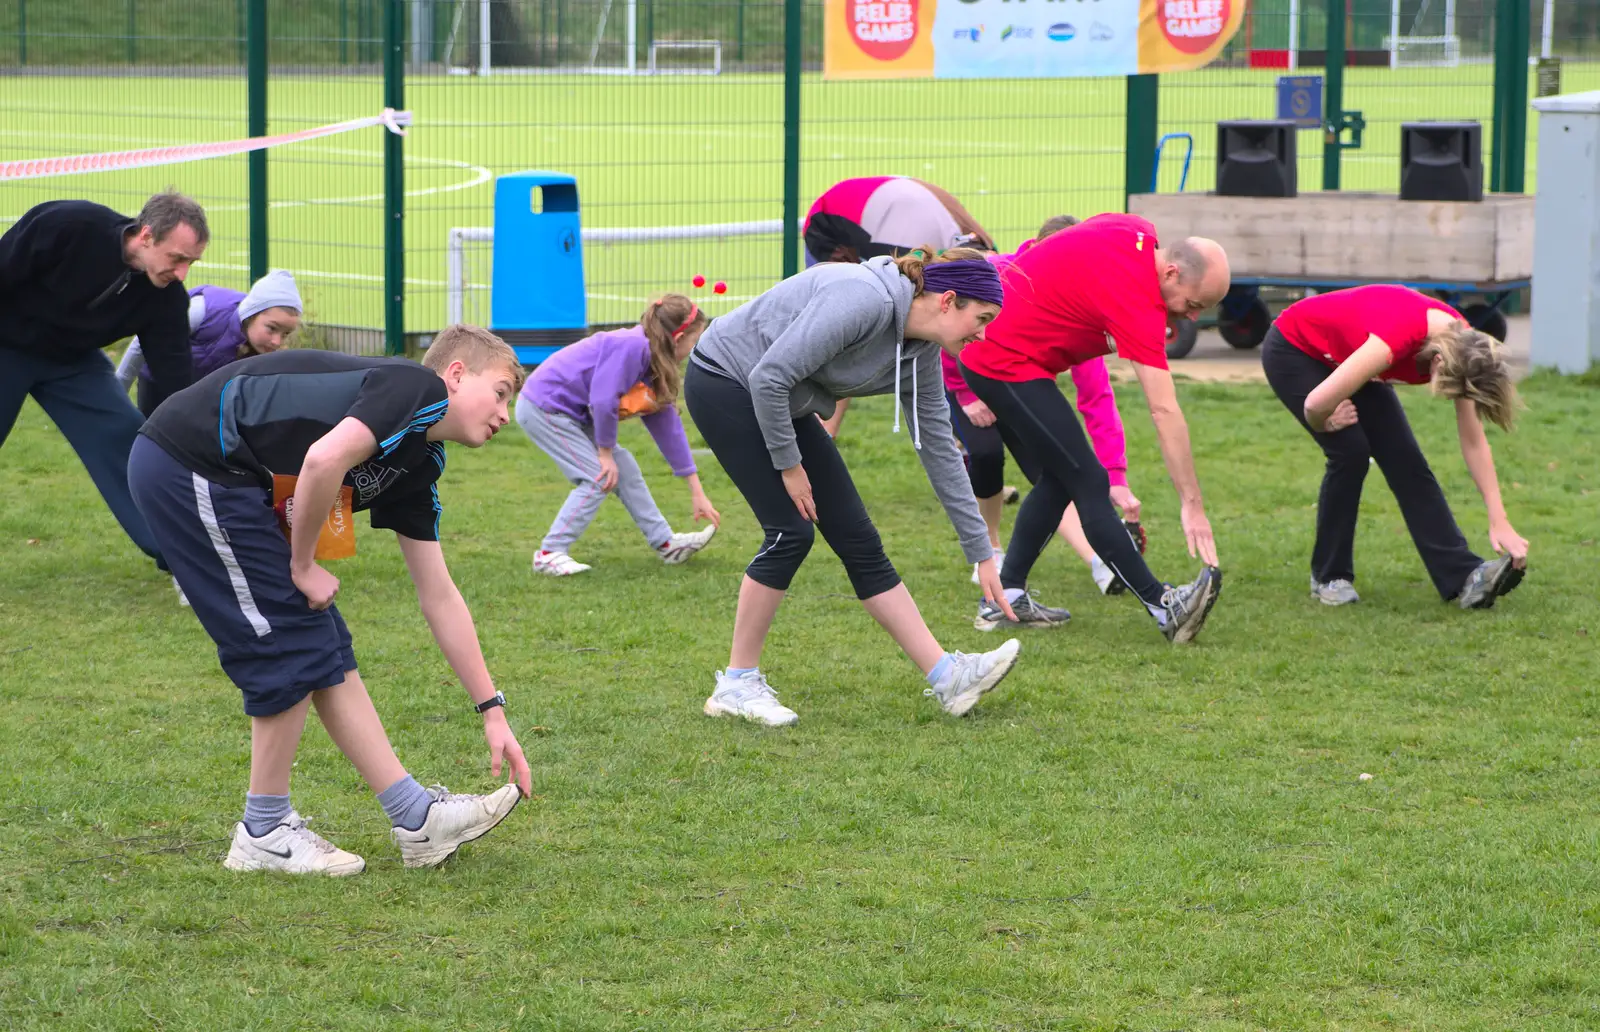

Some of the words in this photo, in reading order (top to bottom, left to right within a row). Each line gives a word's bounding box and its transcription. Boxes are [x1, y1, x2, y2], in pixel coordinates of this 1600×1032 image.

[854, 3, 912, 22] RELIEF
[1164, 0, 1224, 18] RELIEF
[855, 21, 914, 41] GAMES
[1165, 17, 1223, 37] GAMES
